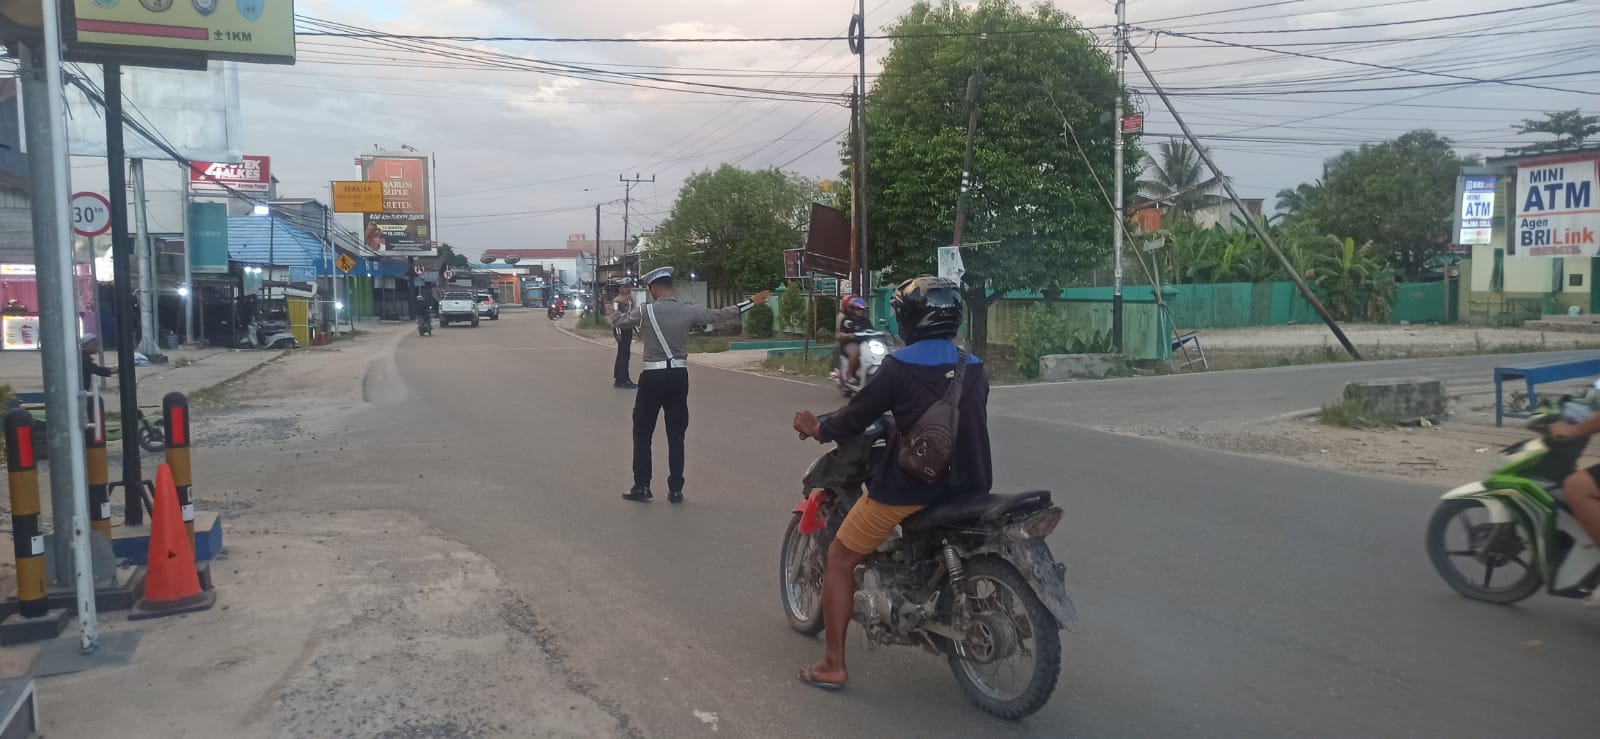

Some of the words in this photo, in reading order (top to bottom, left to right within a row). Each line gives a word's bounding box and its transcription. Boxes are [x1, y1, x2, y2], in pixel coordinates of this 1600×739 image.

[1529, 167, 1564, 183] MINI
[1523, 181, 1591, 212] ATM
[1465, 202, 1491, 216] ATM
[1520, 218, 1548, 230] Agen
